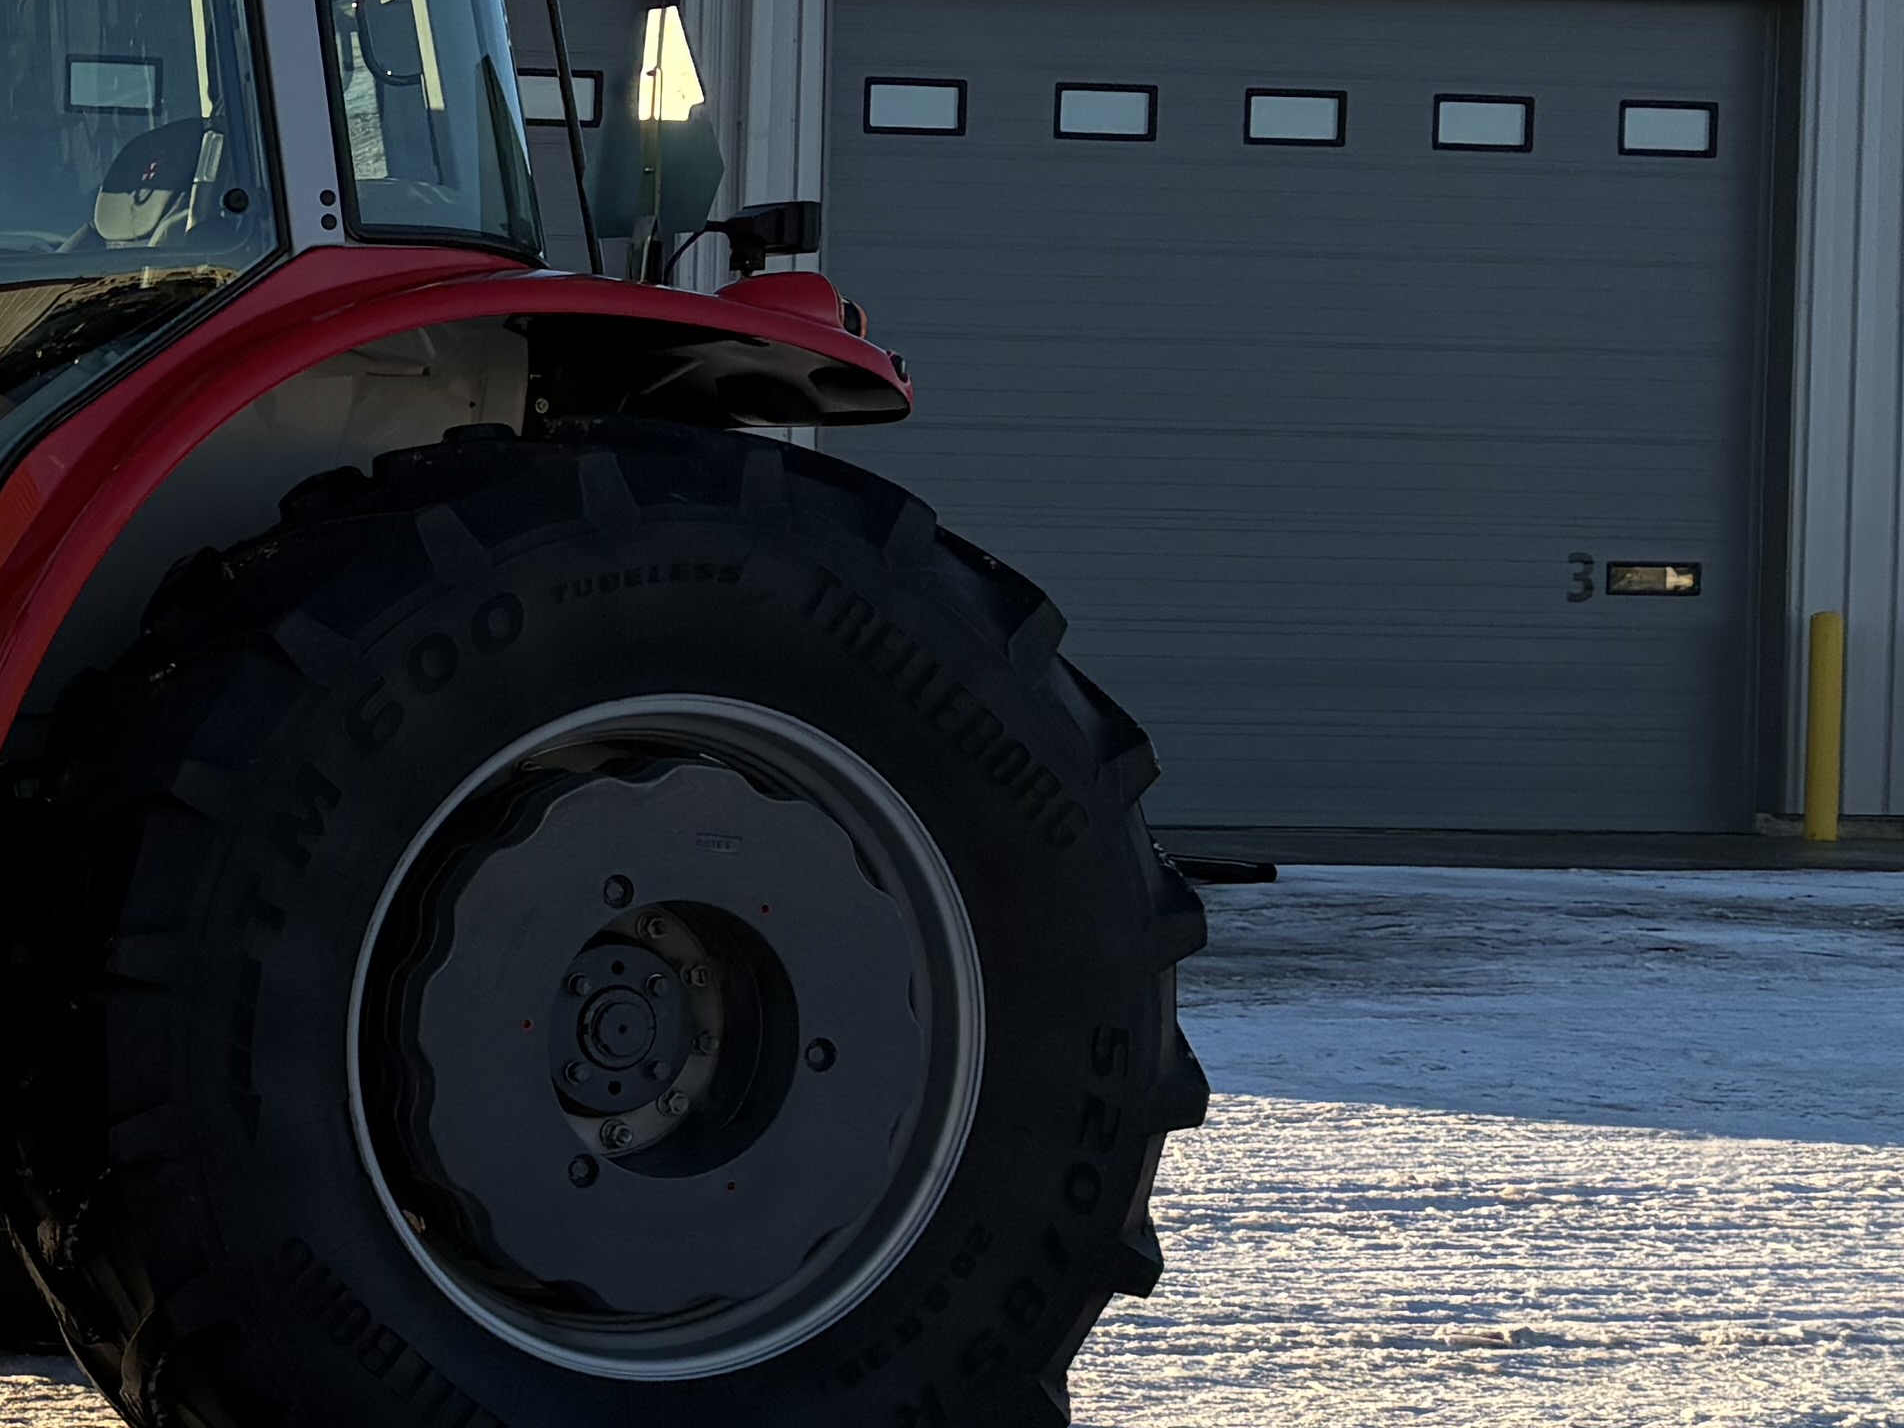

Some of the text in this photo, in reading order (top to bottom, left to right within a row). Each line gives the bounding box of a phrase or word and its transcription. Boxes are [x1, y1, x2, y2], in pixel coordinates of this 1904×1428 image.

[801, 565, 1090, 848] TRELLEBORG
[1565, 551, 1595, 604] 3
[238, 563, 741, 931] TM 600 TUBELESS
